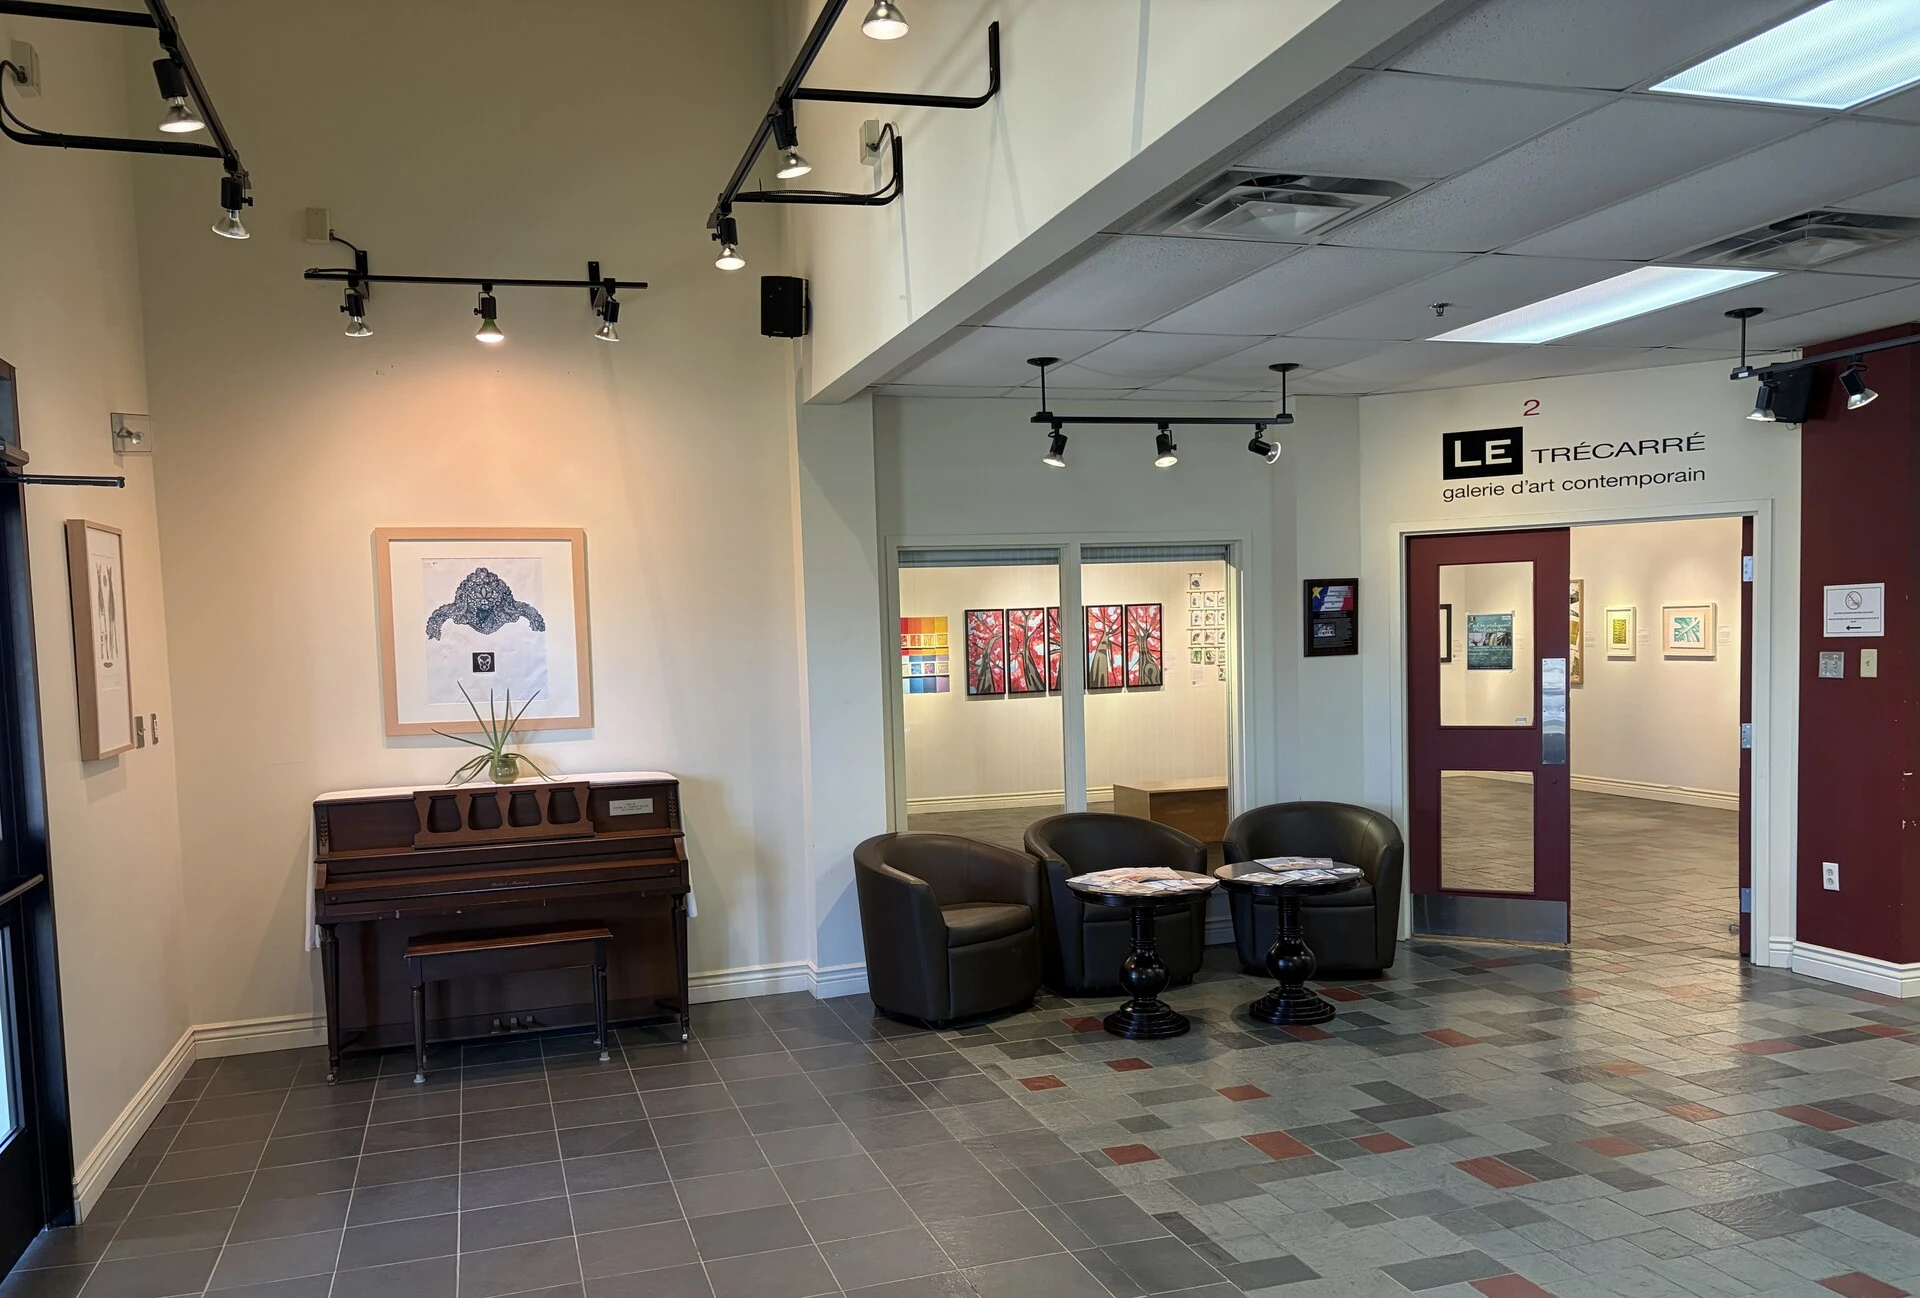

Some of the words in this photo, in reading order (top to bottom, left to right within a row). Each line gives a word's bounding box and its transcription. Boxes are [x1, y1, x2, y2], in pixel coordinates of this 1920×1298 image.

[1523, 399, 1541, 417] 2
[1454, 439, 1512, 468] LE
[1531, 431, 1706, 464] TRÉCARRÉ
[1443, 481, 1505, 503] galerie
[1511, 478, 1555, 496] d'art
[1562, 467, 1706, 491] contemporain
